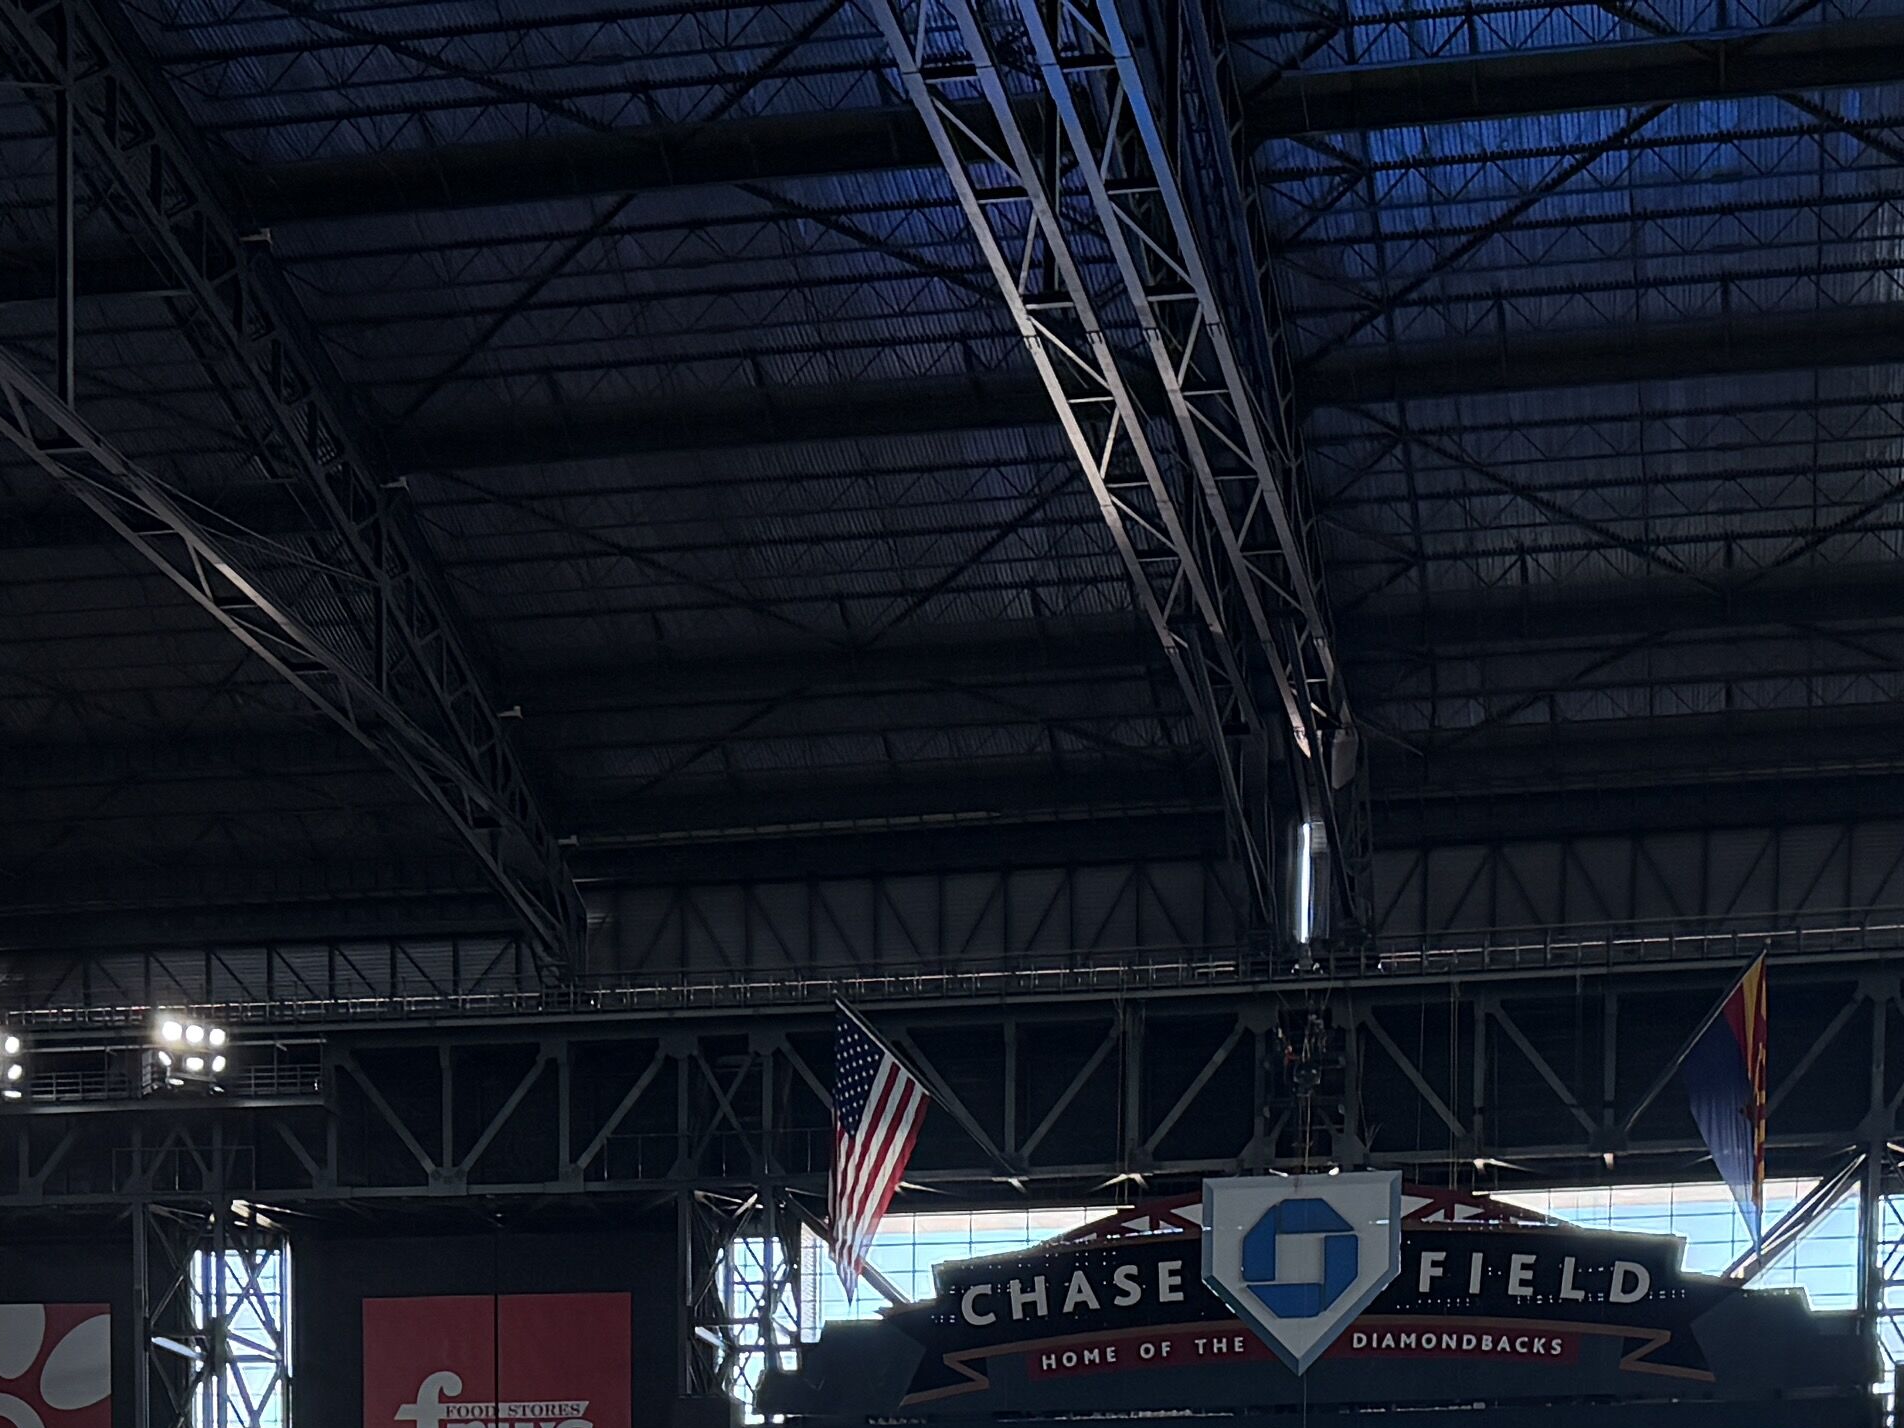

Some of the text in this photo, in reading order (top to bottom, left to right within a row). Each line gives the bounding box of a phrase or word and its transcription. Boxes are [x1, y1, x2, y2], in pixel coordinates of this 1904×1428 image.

[961, 1251, 1651, 1326] CHASE FIELD
[1042, 1332, 1564, 1370] HOME OF THE DIAMONDBACKS
[445, 1401, 583, 1419] FOOD STORES
